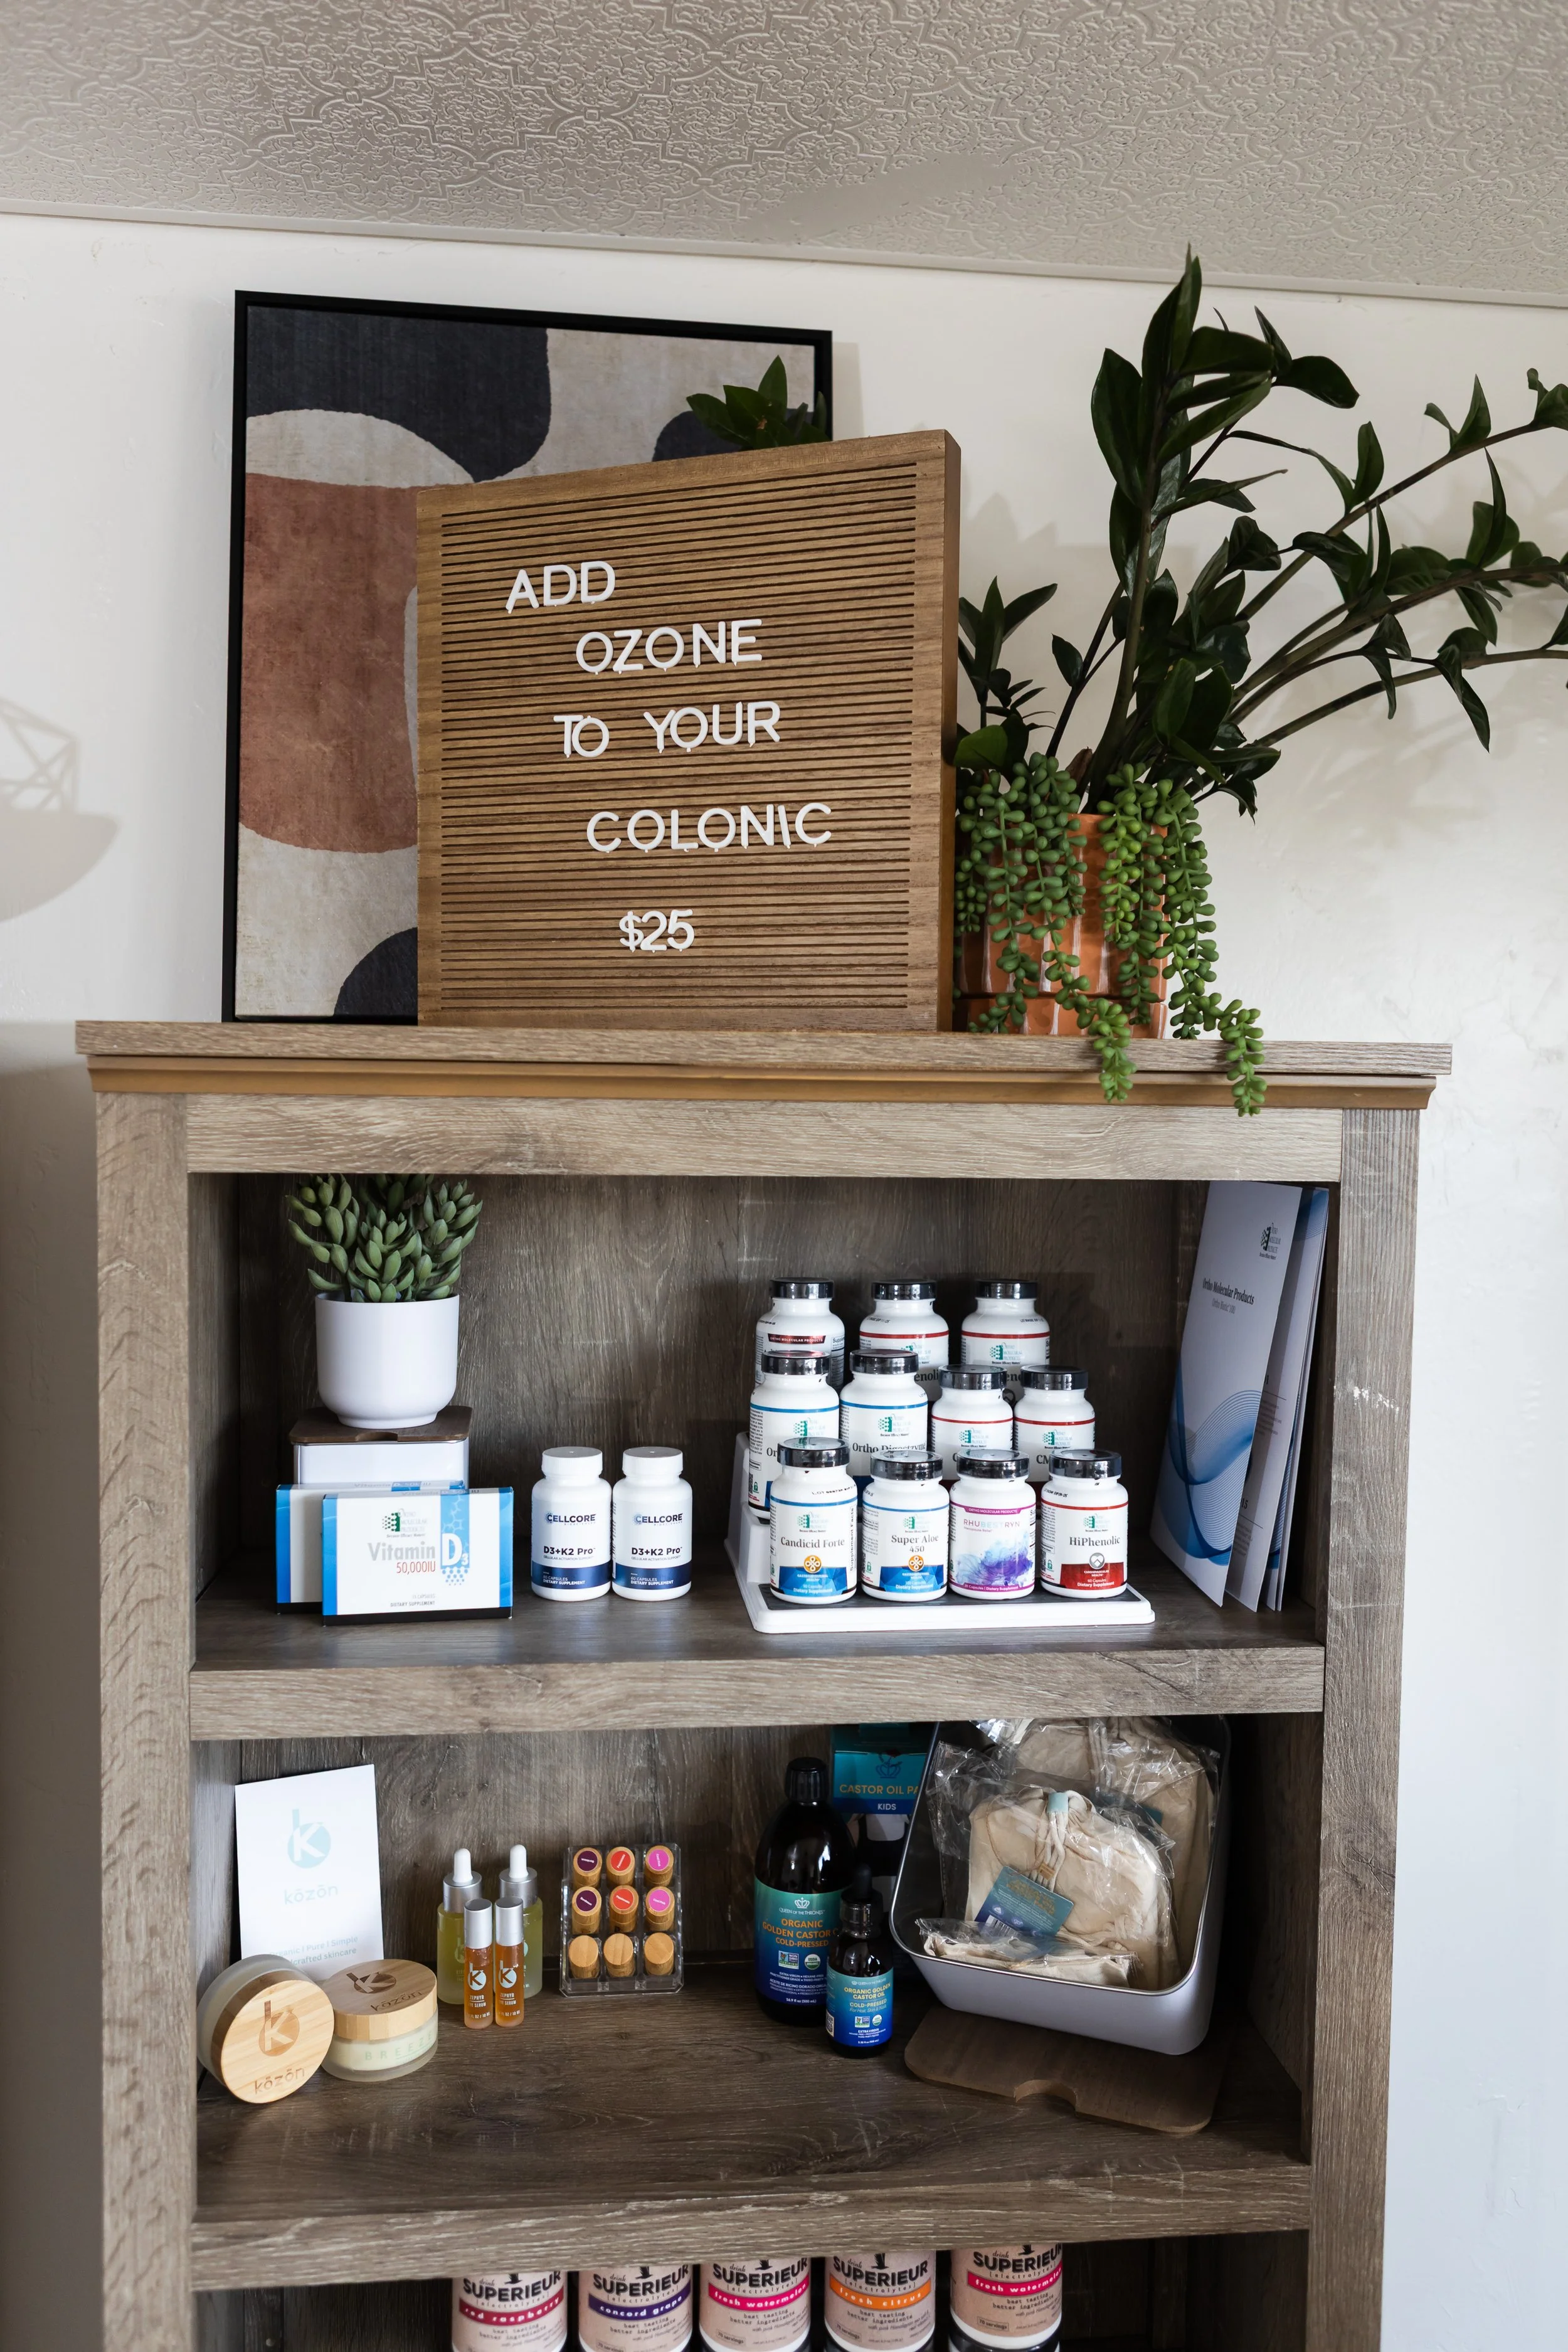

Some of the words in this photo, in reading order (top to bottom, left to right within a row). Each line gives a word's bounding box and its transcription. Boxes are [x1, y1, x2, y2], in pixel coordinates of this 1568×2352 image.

[506, 561, 615, 613] ADD
[576, 618, 762, 674] OZONE
[553, 714, 610, 758] TO
[643, 701, 780, 753] YOUR
[586, 802, 832, 853] COLONIC
[619, 909, 695, 952] $25
[1202, 1278, 1214, 1291] Ortho
[1212, 1281, 1234, 1298] Molecular
[1233, 1288, 1254, 1305] Products
[852, 1443, 879, 1453] Ortho
[546, 1513, 596, 1523] CELLCORE
[633, 1512, 684, 1523] CELLCORE
[963, 1518, 1020, 1528] RHUBESTRYN
[781, 1537, 820, 1549] Candicid
[823, 1539, 845, 1549] Forte
[891, 1535, 919, 1545] Super
[921, 1535, 939, 1543] Aloe
[1069, 1536, 1120, 1547] HiPhenolic
[368, 1541, 436, 1561] Vitamin
[544, 1546, 574, 1555] D3+K2
[631, 1547, 664, 1556] D3+K2
[396, 1561, 436, 1575] 50,000IU
[839, 1784, 883, 1794] CASTOR
[886, 1785, 904, 1794] OIL
[907, 1785, 918, 1794] PA
[284, 1884, 339, 1905] kōzōn
[781, 1918, 824, 1928] ORGANIC
[762, 1921, 793, 1938] GOLDEN
[795, 1929, 831, 1939] CASTOR
[307, 1942, 326, 1951] Pure
[331, 1936, 358, 1947] Simple
[775, 1937, 829, 1948] COLD-PRESSED
[291, 1953, 322, 1966] crafted
[324, 1947, 358, 1961] skincare
[872, 1982, 891, 1993] GOLDEN
[370, 1991, 423, 2012] kōzōn
[849, 1998, 887, 2008] COLD-PRESSED
[365, 2031, 434, 2062] BREEZE
[253, 2065, 306, 2095] kōzōn
[992, 2250, 1010, 2258] drink
[729, 2263, 746, 2272] drink
[847, 2258, 862, 2269] drink
[610, 2273, 627, 2282] drink
[712, 2258, 808, 2288] SUPERIEUR
[833, 2255, 928, 2287] SUPERIEUR
[463, 2270, 561, 2302] SUPERIEUR
[479, 2278, 495, 2287] drink
[593, 2264, 689, 2297] SUPERIEUR
[975, 2279, 1004, 2292] fresh
[714, 2291, 741, 2307] fresh
[746, 2283, 806, 2308] watermelon
[840, 2287, 873, 2306] fresh
[886, 2292, 921, 2307] citrus
[1020, 2294, 1054, 2310] ingredients
[1026, 2292, 1049, 2303] tasting
[465, 2309, 484, 2319] red
[492, 2297, 559, 2323] raspberry
[600, 2305, 647, 2318] concord
[652, 2296, 682, 2316] grape
[860, 2309, 876, 2318] best
[730, 2316, 753, 2325] better
[757, 2311, 795, 2326] ingredients
[763, 2309, 788, 2319] tasting
[847, 2311, 869, 2323] better
[872, 2314, 913, 2325] ingredients
[520, 2324, 539, 2333] tasting
[610, 2326, 633, 2334] better
[637, 2318, 676, 2334] ingredients
[644, 2316, 669, 2328] tasting
[985, 2321, 1007, 2330] servings
[479, 2331, 501, 2340] better
[506, 2326, 546, 2340] ingredients
[724, 2334, 744, 2344] servings
[842, 2328, 860, 2339] servings
[603, 2344, 624, 2352] servings
